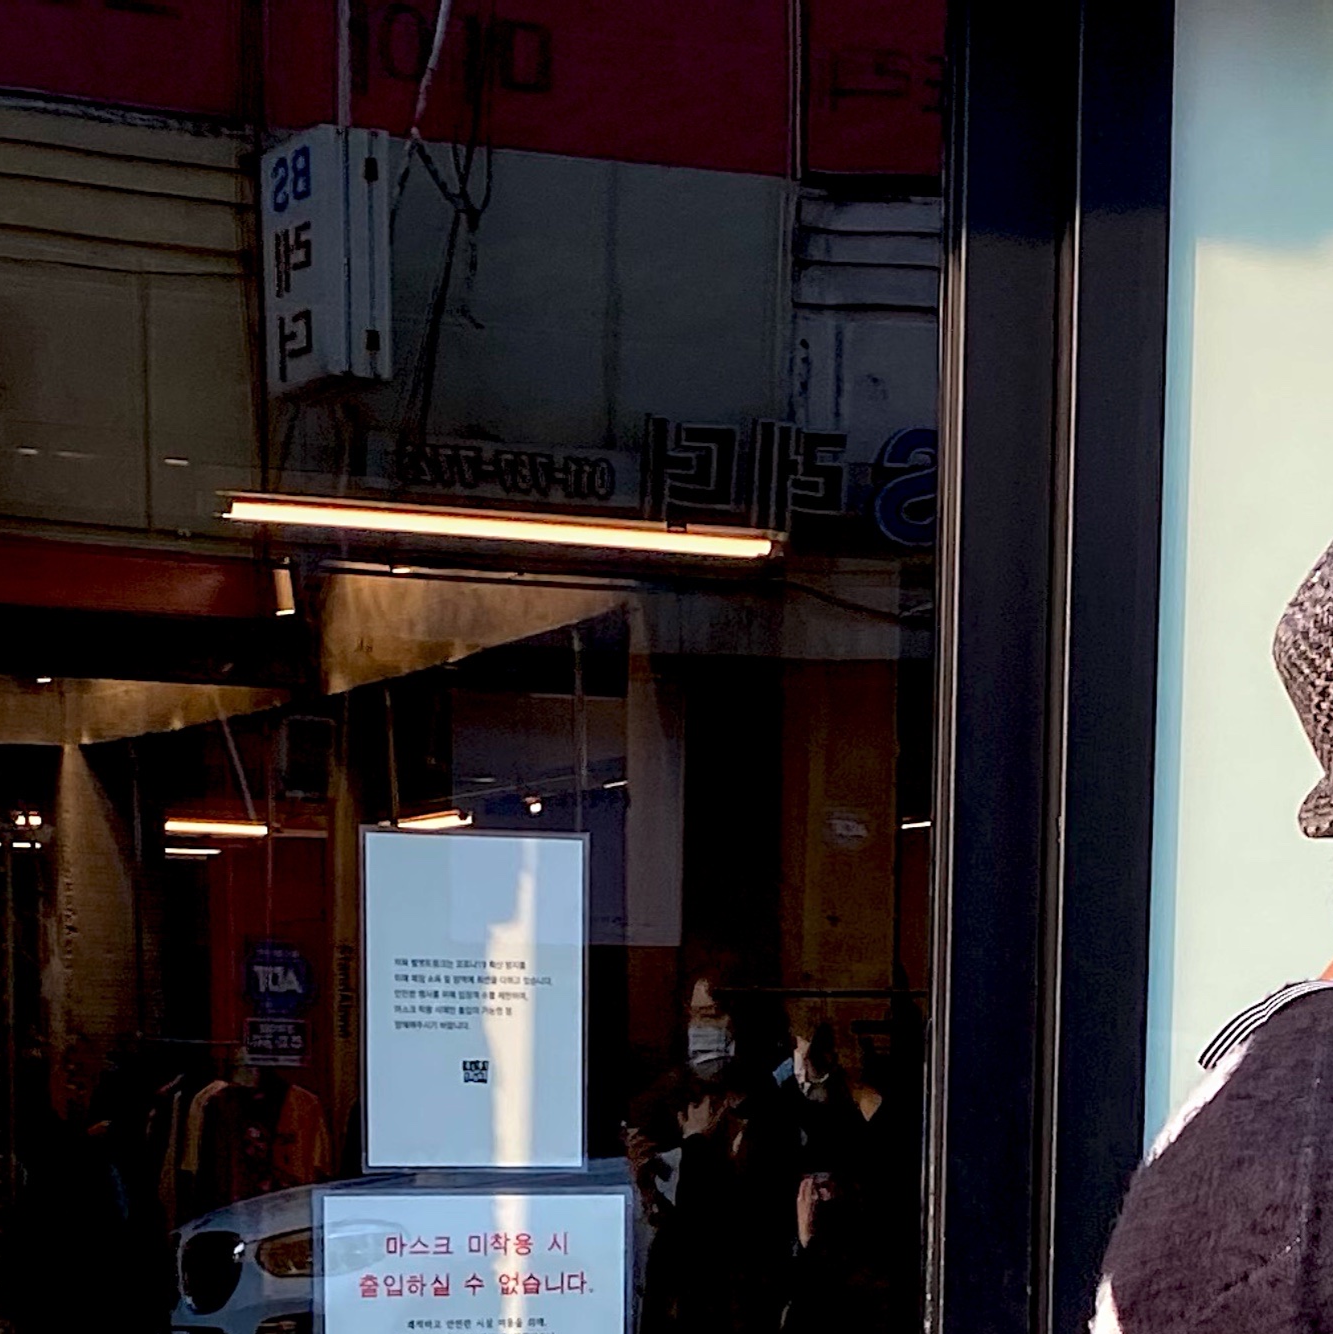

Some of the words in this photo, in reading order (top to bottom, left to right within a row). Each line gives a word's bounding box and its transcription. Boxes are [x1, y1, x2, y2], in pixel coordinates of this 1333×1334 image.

[386, 1233, 453, 1257] 마스크
[468, 1232, 533, 1256] 미착용
[547, 1232, 568, 1255] 시
[360, 1273, 450, 1297] 출입하실
[465, 1273, 484, 1295] 수
[499, 1271, 594, 1295] 없습니다.
